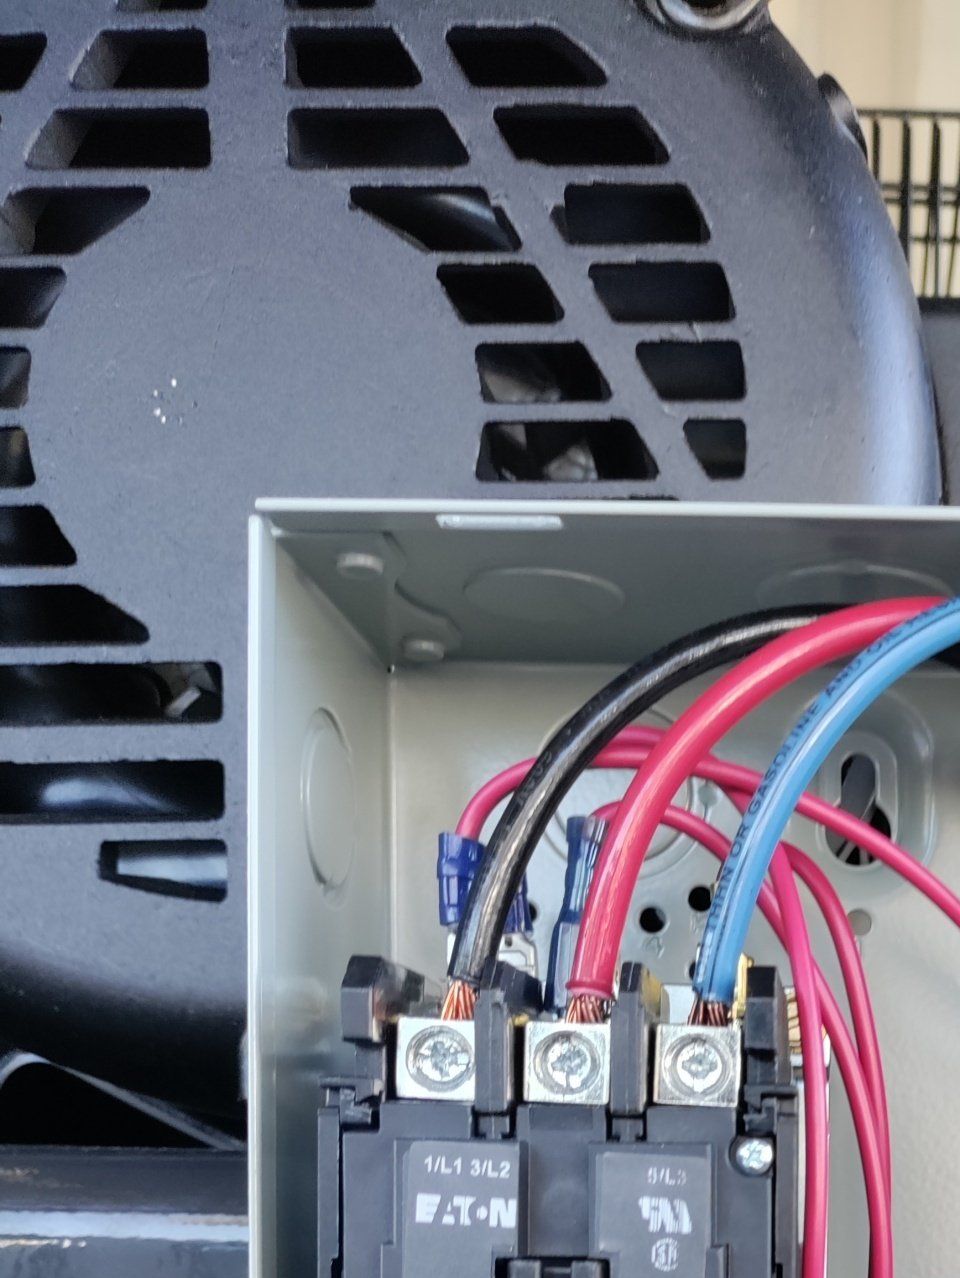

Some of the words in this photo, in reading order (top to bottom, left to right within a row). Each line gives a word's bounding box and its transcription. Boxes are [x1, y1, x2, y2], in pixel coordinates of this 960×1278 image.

[731, 825, 750, 858] OR
[748, 703, 819, 816] GASOLINE
[423, 1155, 463, 1175] 1/L1
[470, 1158, 512, 1179] 3/L2
